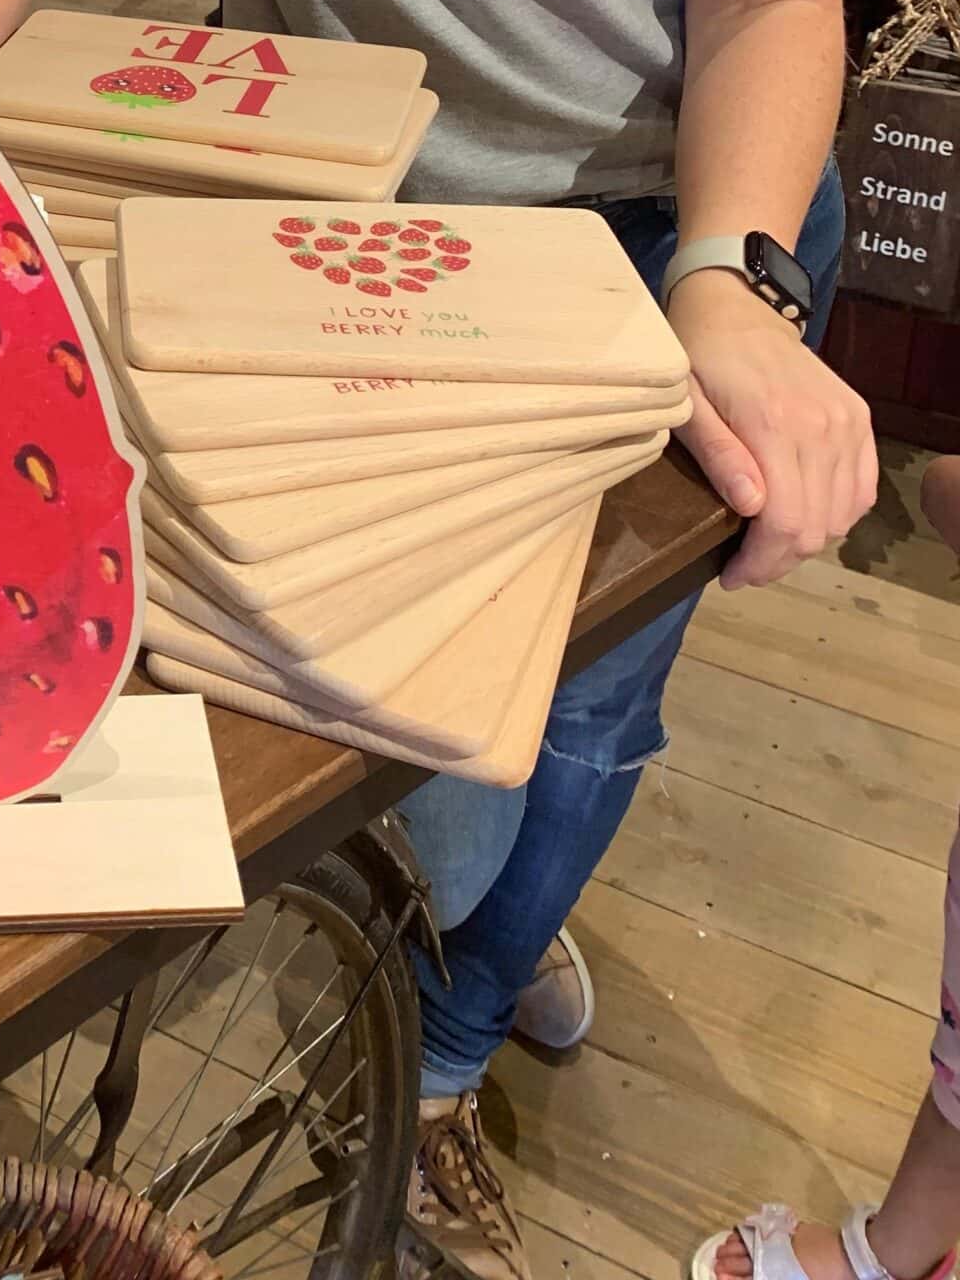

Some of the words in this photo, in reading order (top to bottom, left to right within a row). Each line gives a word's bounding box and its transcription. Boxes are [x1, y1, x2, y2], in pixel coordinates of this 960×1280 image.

[872, 122, 954, 156] Sonne
[860, 176, 947, 212] Strand
[859, 230, 928, 263] Liebe
[344, 306, 413, 320] LOVE
[421, 311, 469, 322] you
[320, 322, 404, 336] BERRY
[419, 326, 489, 340] much
[332, 377, 416, 395] BERRY
